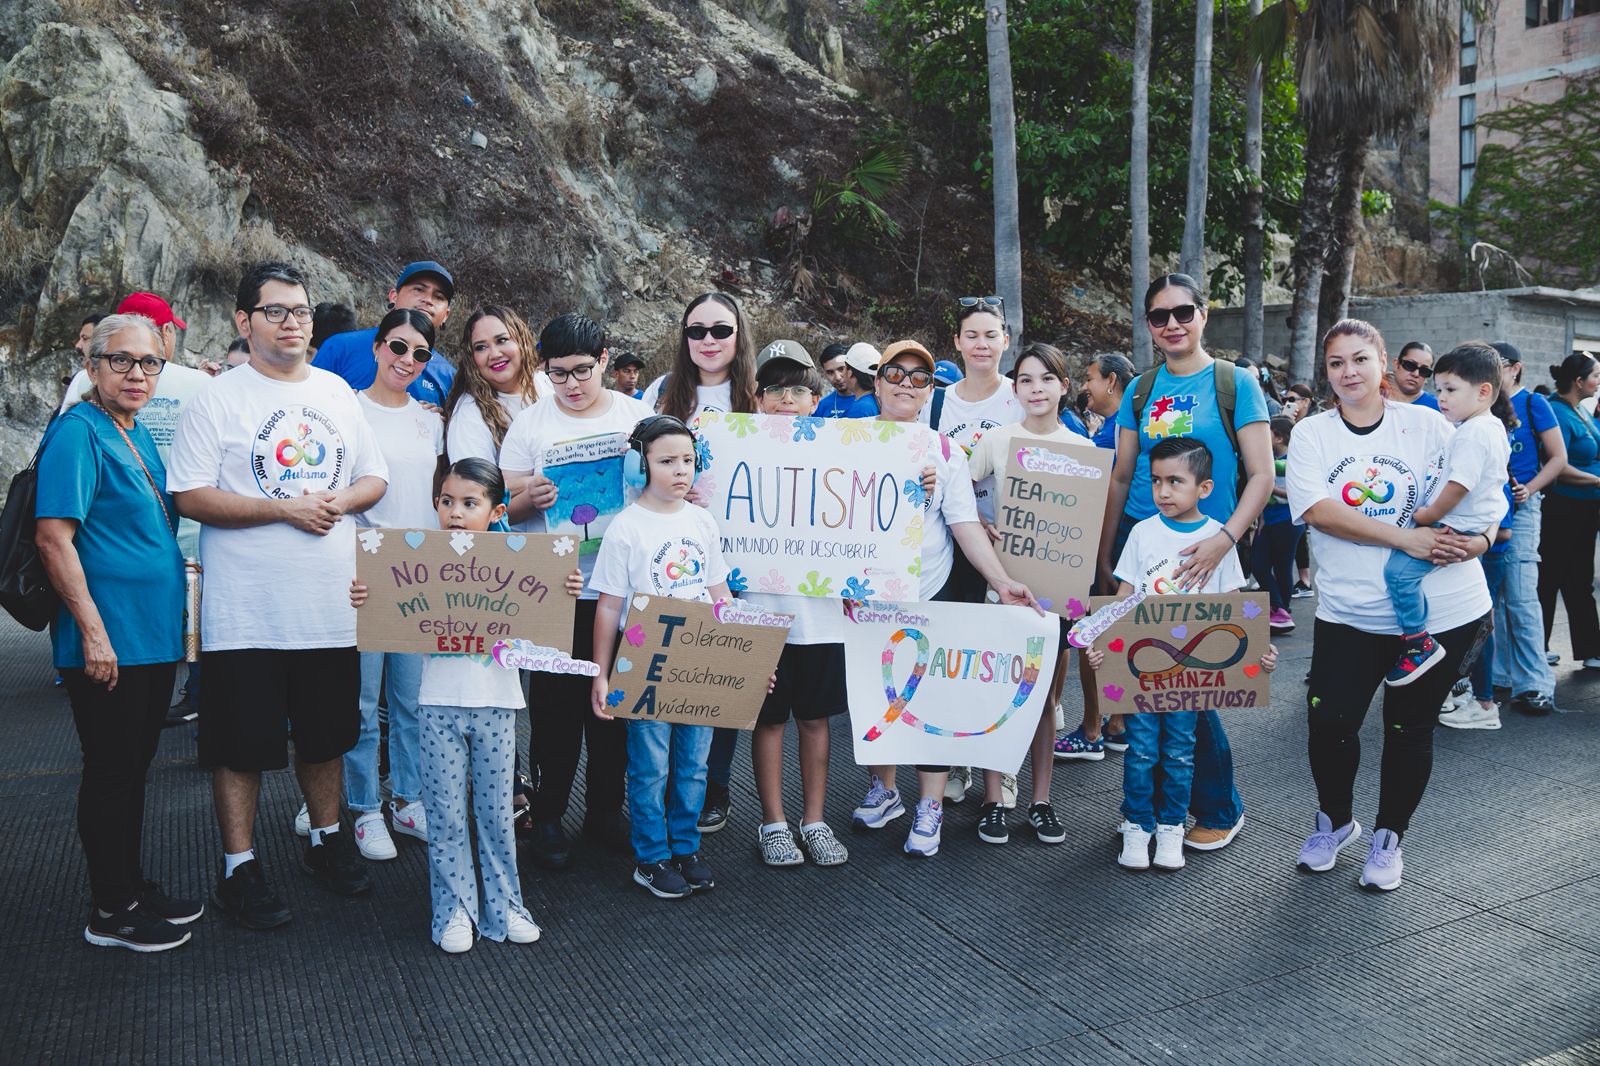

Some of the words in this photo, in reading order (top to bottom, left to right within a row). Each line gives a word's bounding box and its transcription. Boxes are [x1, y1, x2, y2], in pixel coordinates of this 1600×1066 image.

[258, 409, 286, 441] Respeto
[302, 407, 337, 436] Equidad
[254, 455, 268, 480] Amor
[1328, 456, 1356, 485] Respeto
[1372, 455, 1410, 475] Equidad
[725, 461, 899, 532] AUTISMO
[1363, 507, 1396, 518] tismo
[654, 541, 672, 565] Respeto
[720, 537, 733, 554] UN
[736, 536, 779, 555] MUNDO
[784, 538, 805, 556] POR
[811, 540, 878, 560] DESCUBRIR
[1146, 558, 1169, 577] Respeto
[439, 556, 515, 593] estoy
[518, 574, 549, 604] en
[653, 572, 663, 590] Amor
[669, 577, 703, 590] Autismo
[397, 592, 430, 618] mi
[445, 591, 520, 617] mundo
[722, 609, 757, 624] Esther
[857, 610, 893, 623] Esther
[1135, 602, 1233, 625] AUTISMO
[419, 614, 479, 638] estoy
[486, 621, 511, 635] en
[437, 635, 485, 653] ESTE
[505, 652, 550, 670] Esther
[929, 647, 1024, 685] AUTISMO
[1139, 670, 1227, 692] CRIANZA
[1133, 689, 1258, 713] RESPETUOSA
